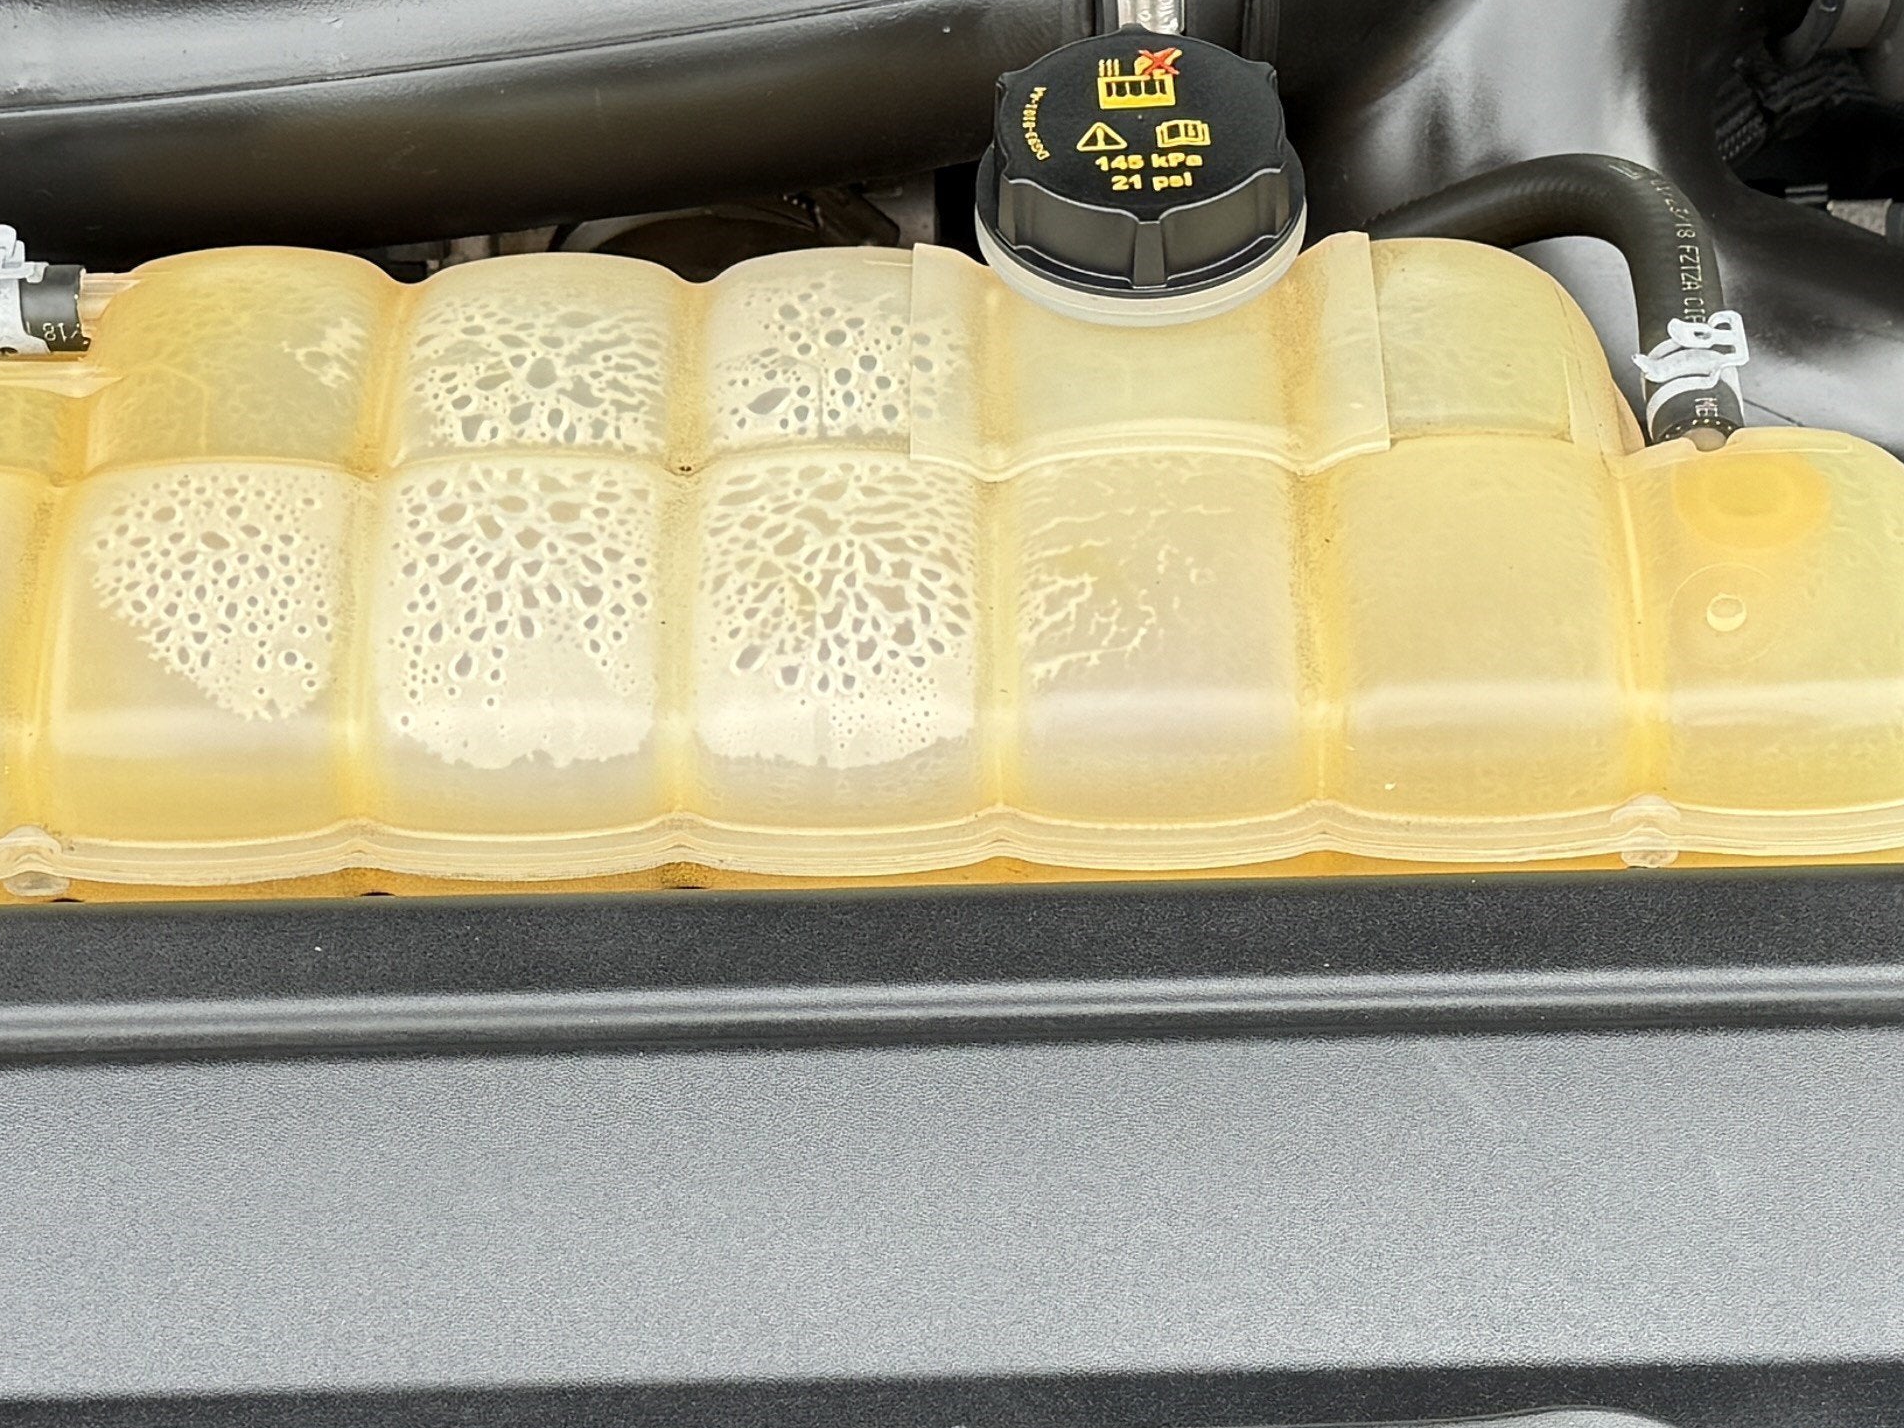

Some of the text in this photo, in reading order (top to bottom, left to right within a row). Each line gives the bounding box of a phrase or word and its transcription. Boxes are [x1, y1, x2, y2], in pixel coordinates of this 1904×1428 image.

[1094, 152, 1204, 172] 145 kPa
[1110, 171, 1193, 192] 21 psi
